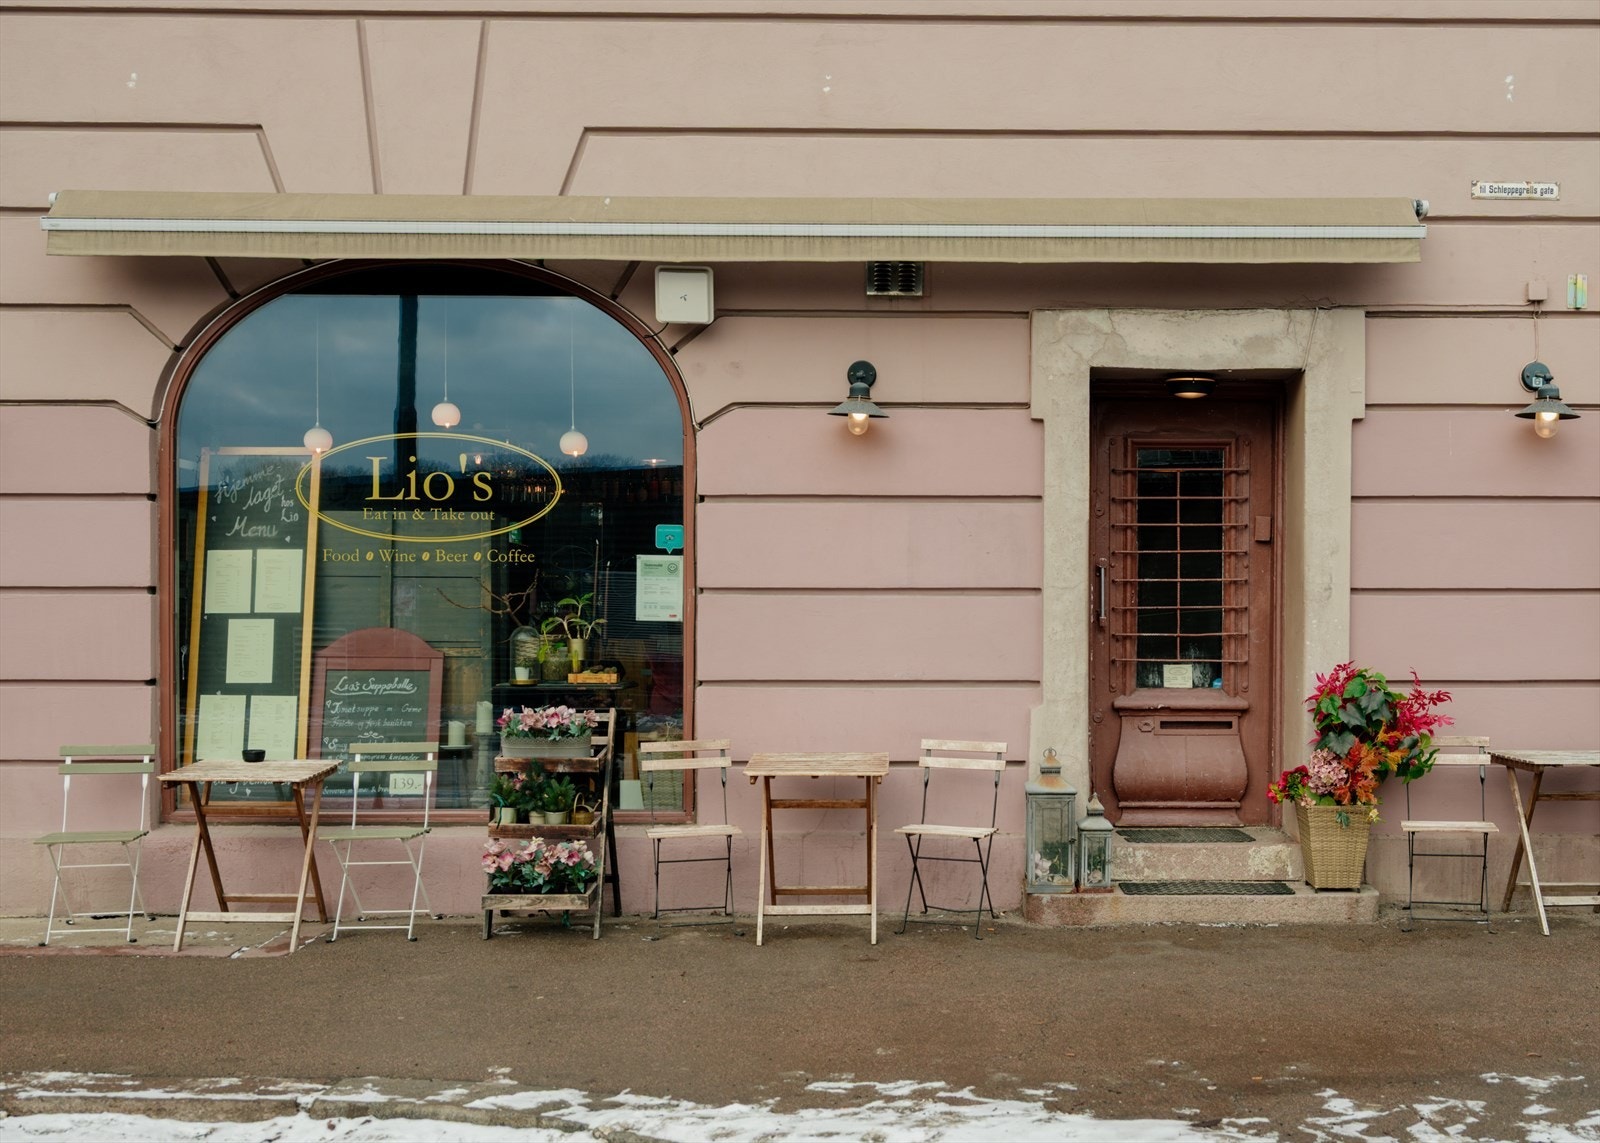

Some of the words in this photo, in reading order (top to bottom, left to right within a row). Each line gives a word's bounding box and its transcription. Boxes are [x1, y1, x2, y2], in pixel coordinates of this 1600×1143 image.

[1540, 186, 1554, 196] gate
[365, 453, 493, 501] Lio's
[363, 507, 387, 520] Eat
[393, 507, 407, 520] in
[412, 508, 425, 520] &
[430, 507, 466, 520] Take
[471, 509, 495, 520] out
[322, 548, 360, 563] Food
[379, 548, 416, 563] Wine
[435, 548, 468, 563] Beer
[487, 548, 535, 563] Coffee
